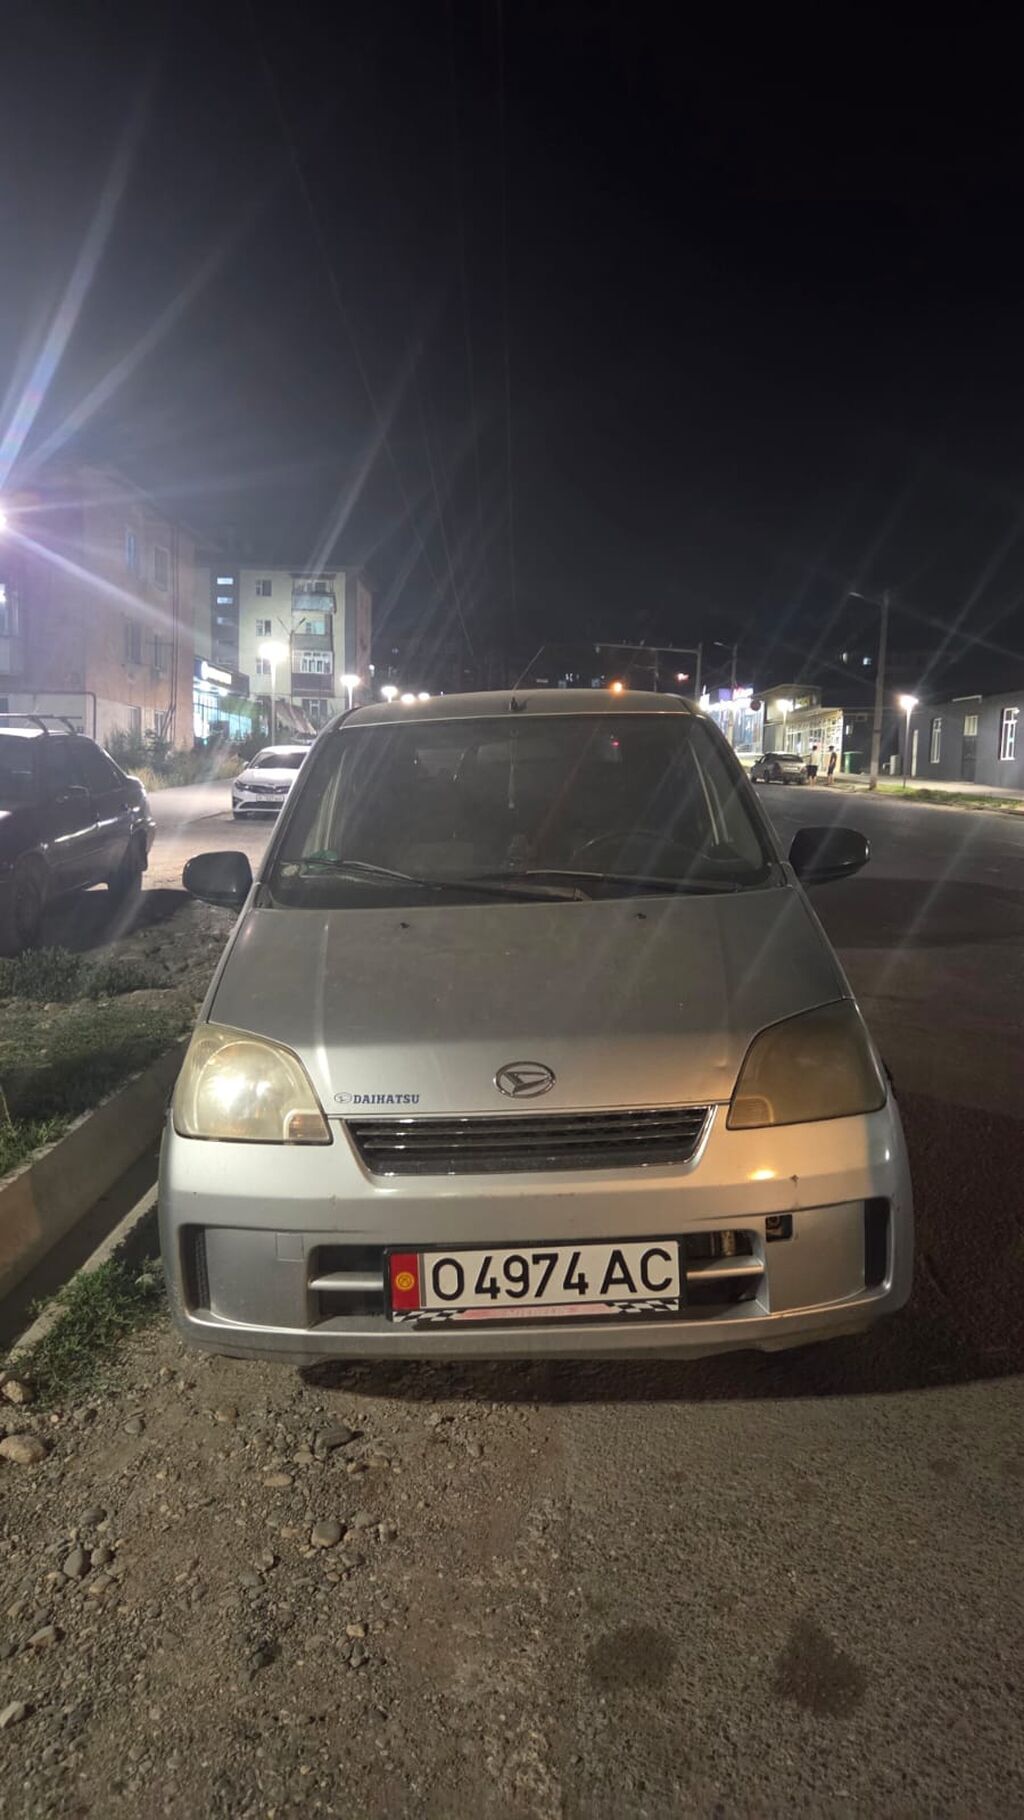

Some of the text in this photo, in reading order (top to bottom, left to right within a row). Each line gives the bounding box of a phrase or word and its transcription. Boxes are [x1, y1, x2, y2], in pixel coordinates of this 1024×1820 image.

[353, 1094, 420, 1104] DAIHATSU
[475, 1252, 589, 1300] 4974
[600, 1248, 673, 1295] AC
